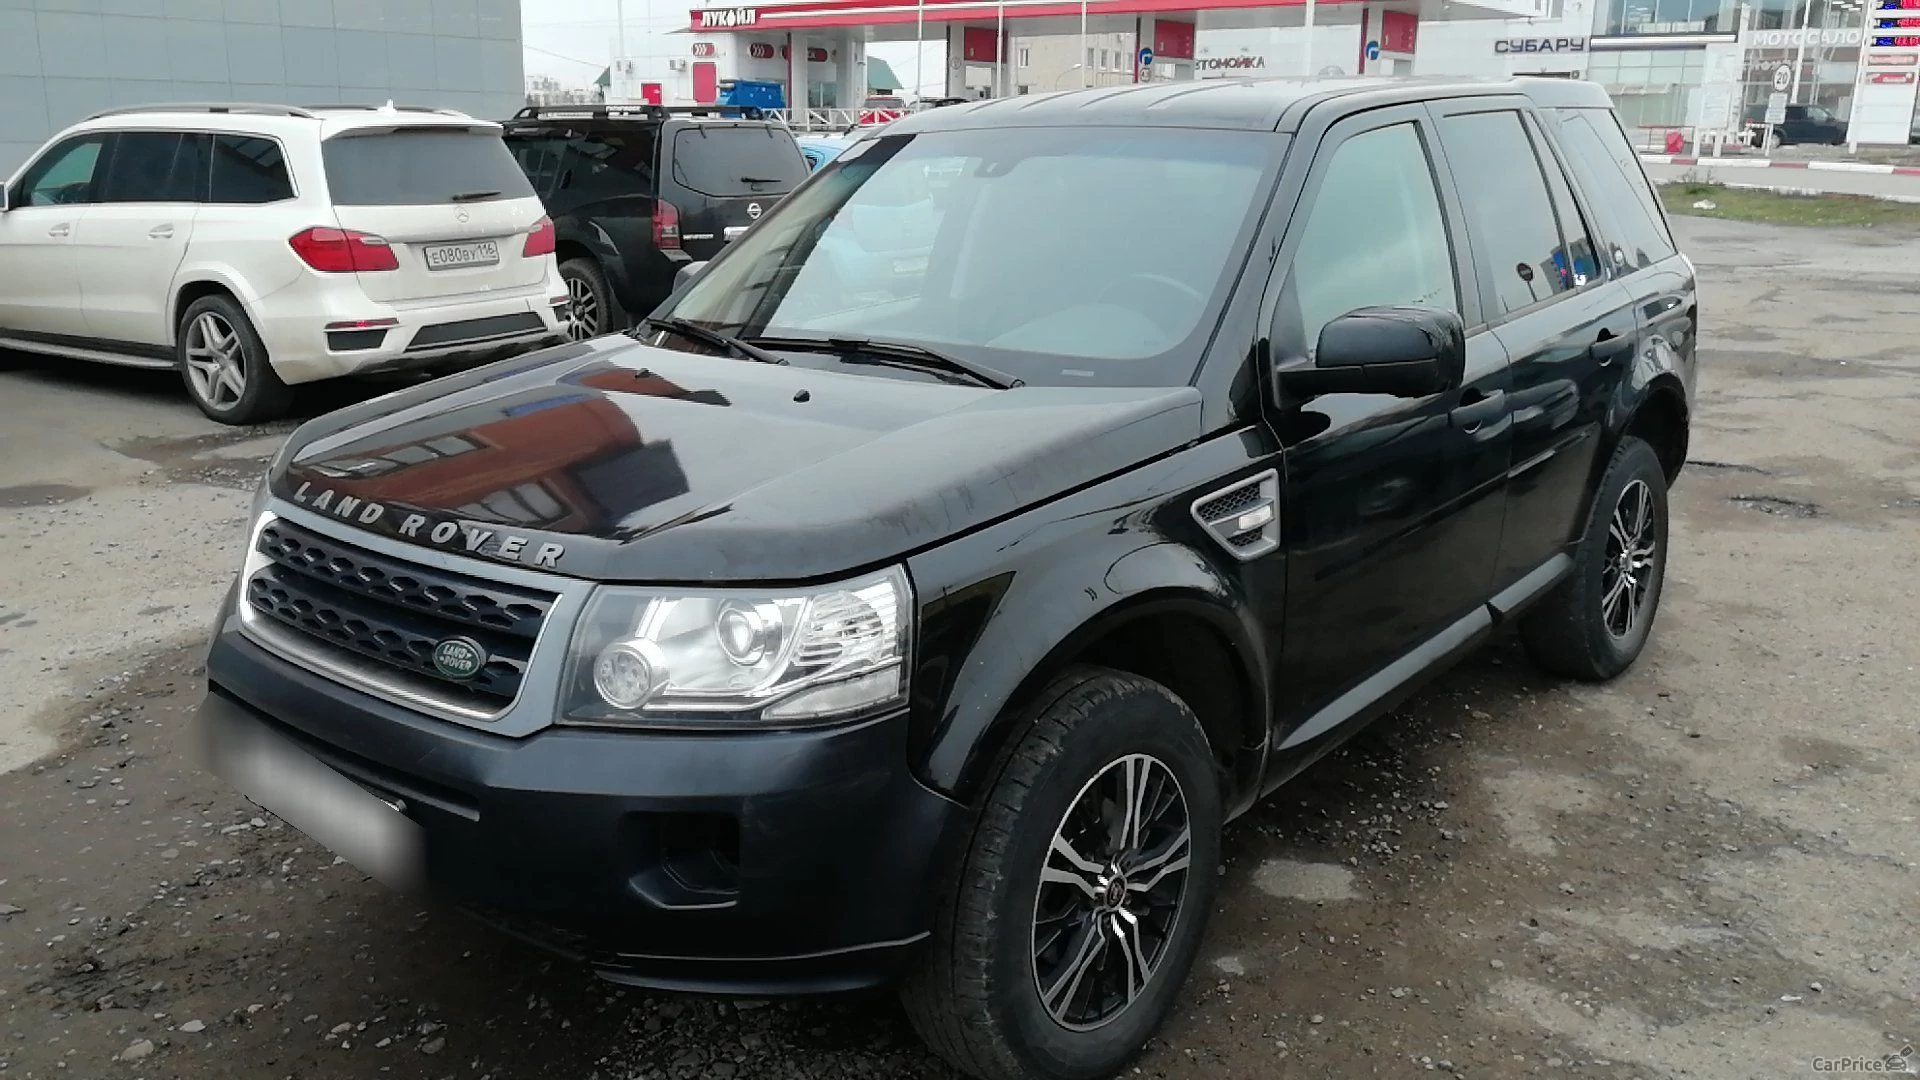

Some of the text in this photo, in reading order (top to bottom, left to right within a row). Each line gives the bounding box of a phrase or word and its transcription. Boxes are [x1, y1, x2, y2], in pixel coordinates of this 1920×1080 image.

[702, 8, 756, 27] ЛУКОЙЛ
[1494, 37, 1584, 54] СУБАРУ
[1753, 30, 1860, 46] МОТОСАЛО
[1195, 55, 1266, 71] ВТОМОЙКА
[1776, 71, 1790, 85] 20
[293, 481, 566, 569] LAND ROVER
[443, 644, 468, 659] LAND
[443, 656, 472, 671] ROVER
